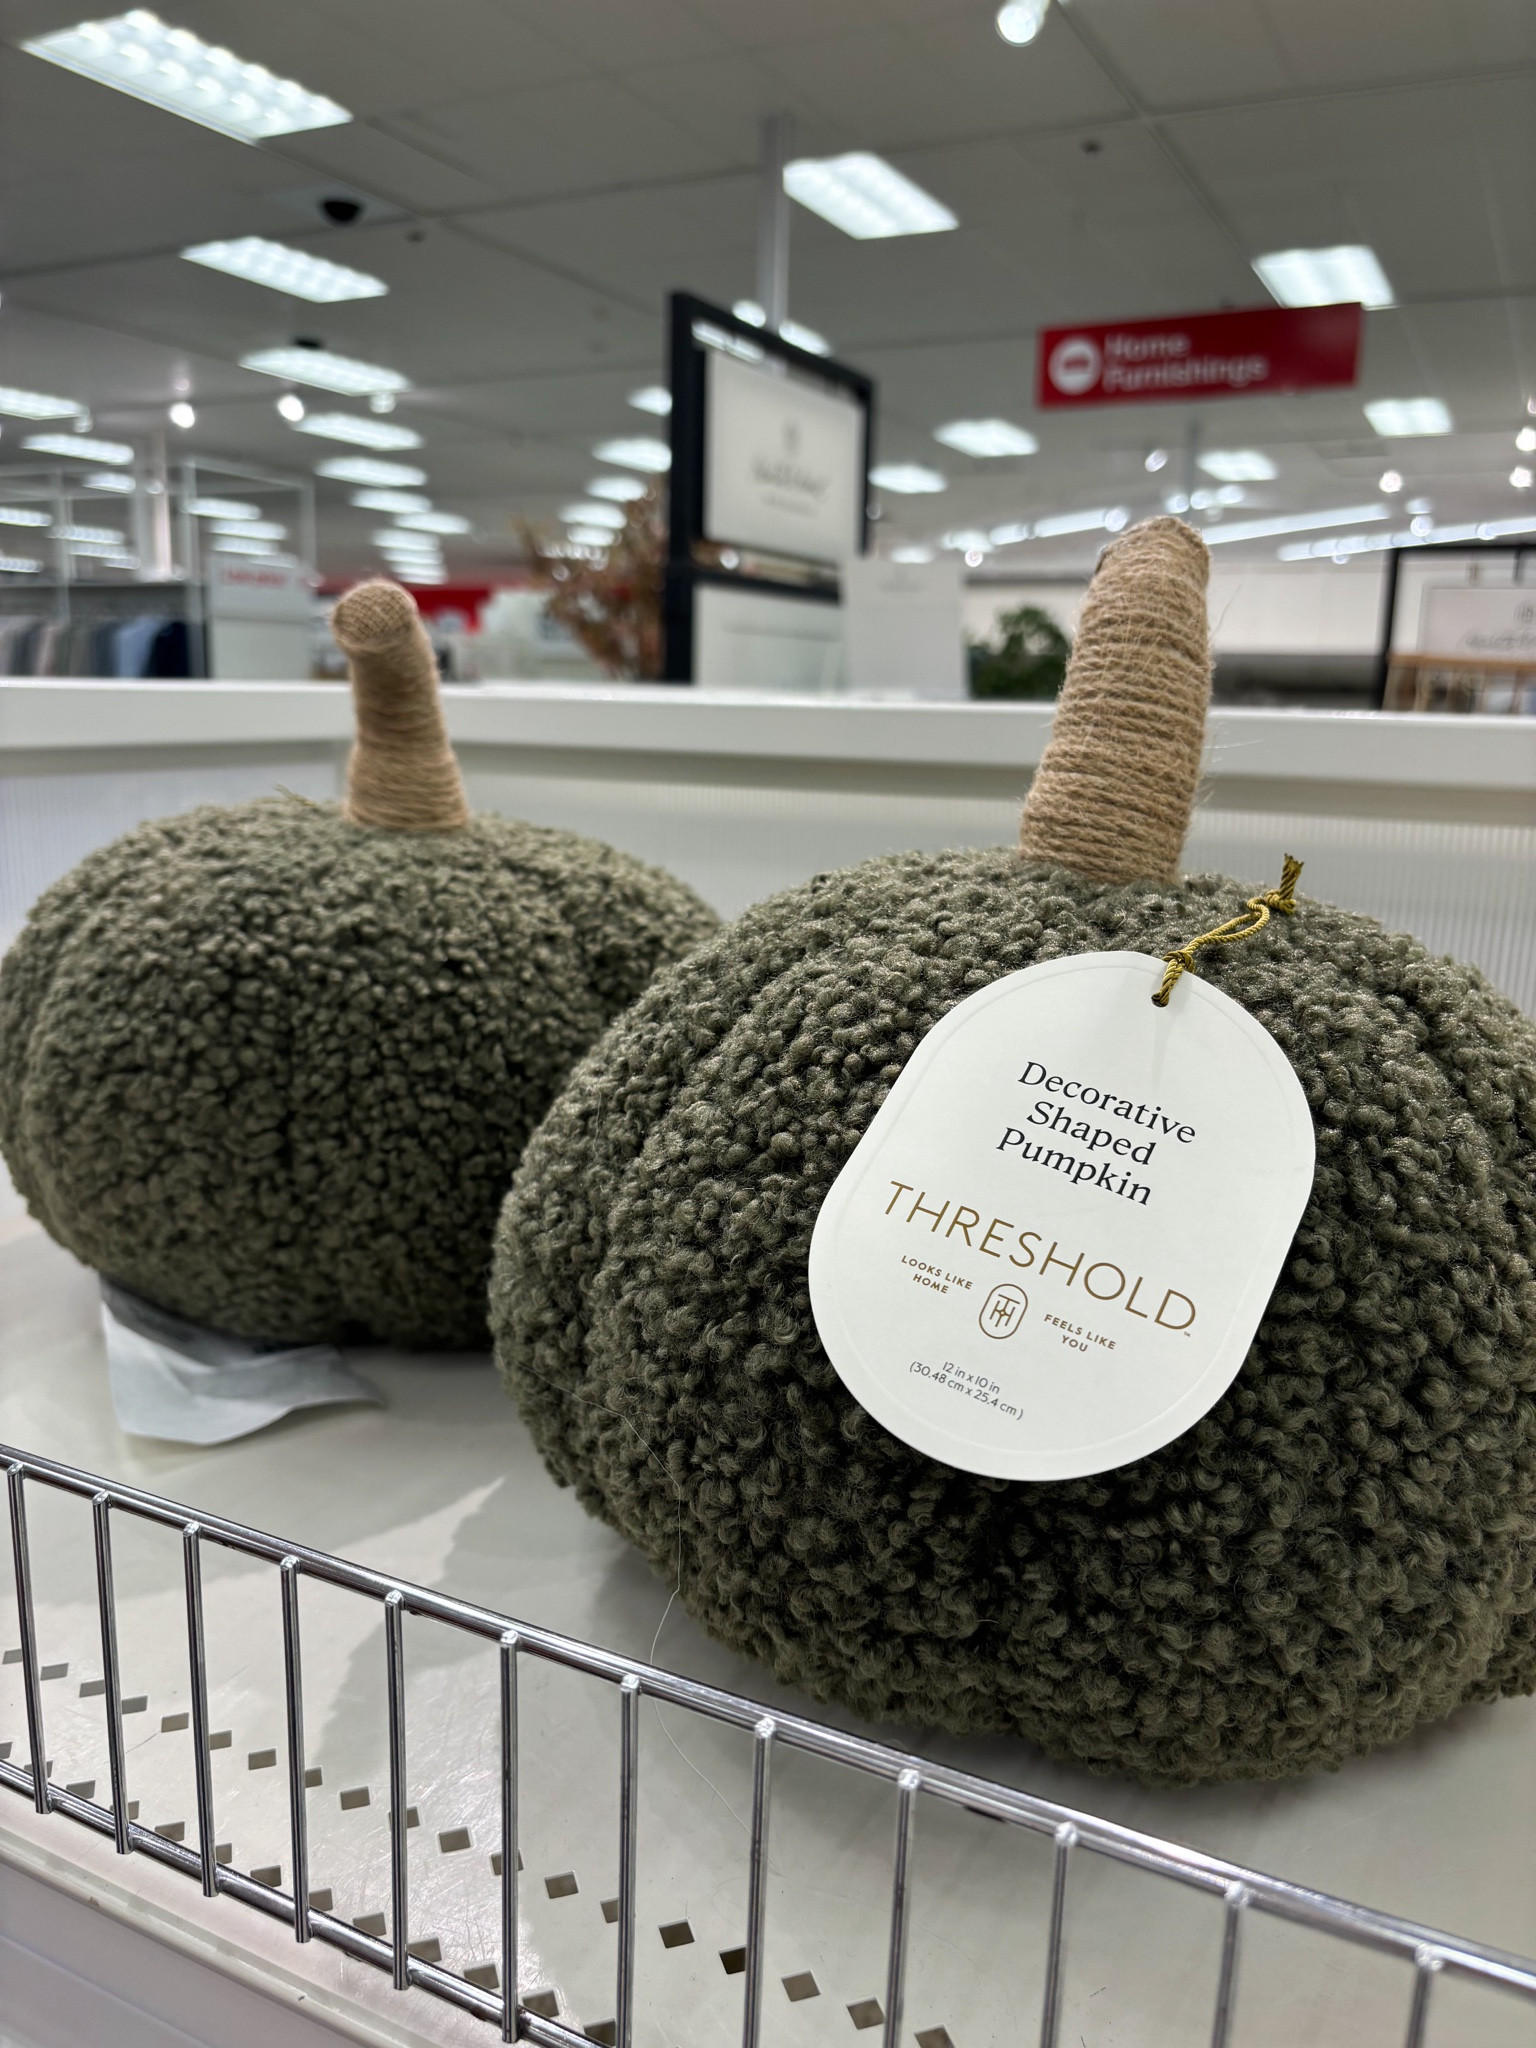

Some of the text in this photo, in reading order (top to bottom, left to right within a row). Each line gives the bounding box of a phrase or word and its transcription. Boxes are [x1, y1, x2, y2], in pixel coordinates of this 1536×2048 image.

[1018, 1061, 1197, 1144] Decorative
[1026, 1101, 1157, 1166] Shaped
[996, 1127, 1152, 1206] Pumpkin
[885, 1180, 1197, 1331] THRESHOLD
[901, 1255, 973, 1290] LOOKS LIKE
[912, 1273, 949, 1294] HOME
[1043, 1313, 1117, 1350] FEELS LIKE
[1062, 1335, 1089, 1352] YOU
[909, 1361, 947, 1384] (30.48
[947, 1379, 965, 1393] cm
[973, 1389, 999, 1408] 25.4
[942, 1361, 955, 1373] 12
[955, 1368, 966, 1379] in
[974, 1376, 989, 1389] 10
[989, 1382, 1001, 1394] in
